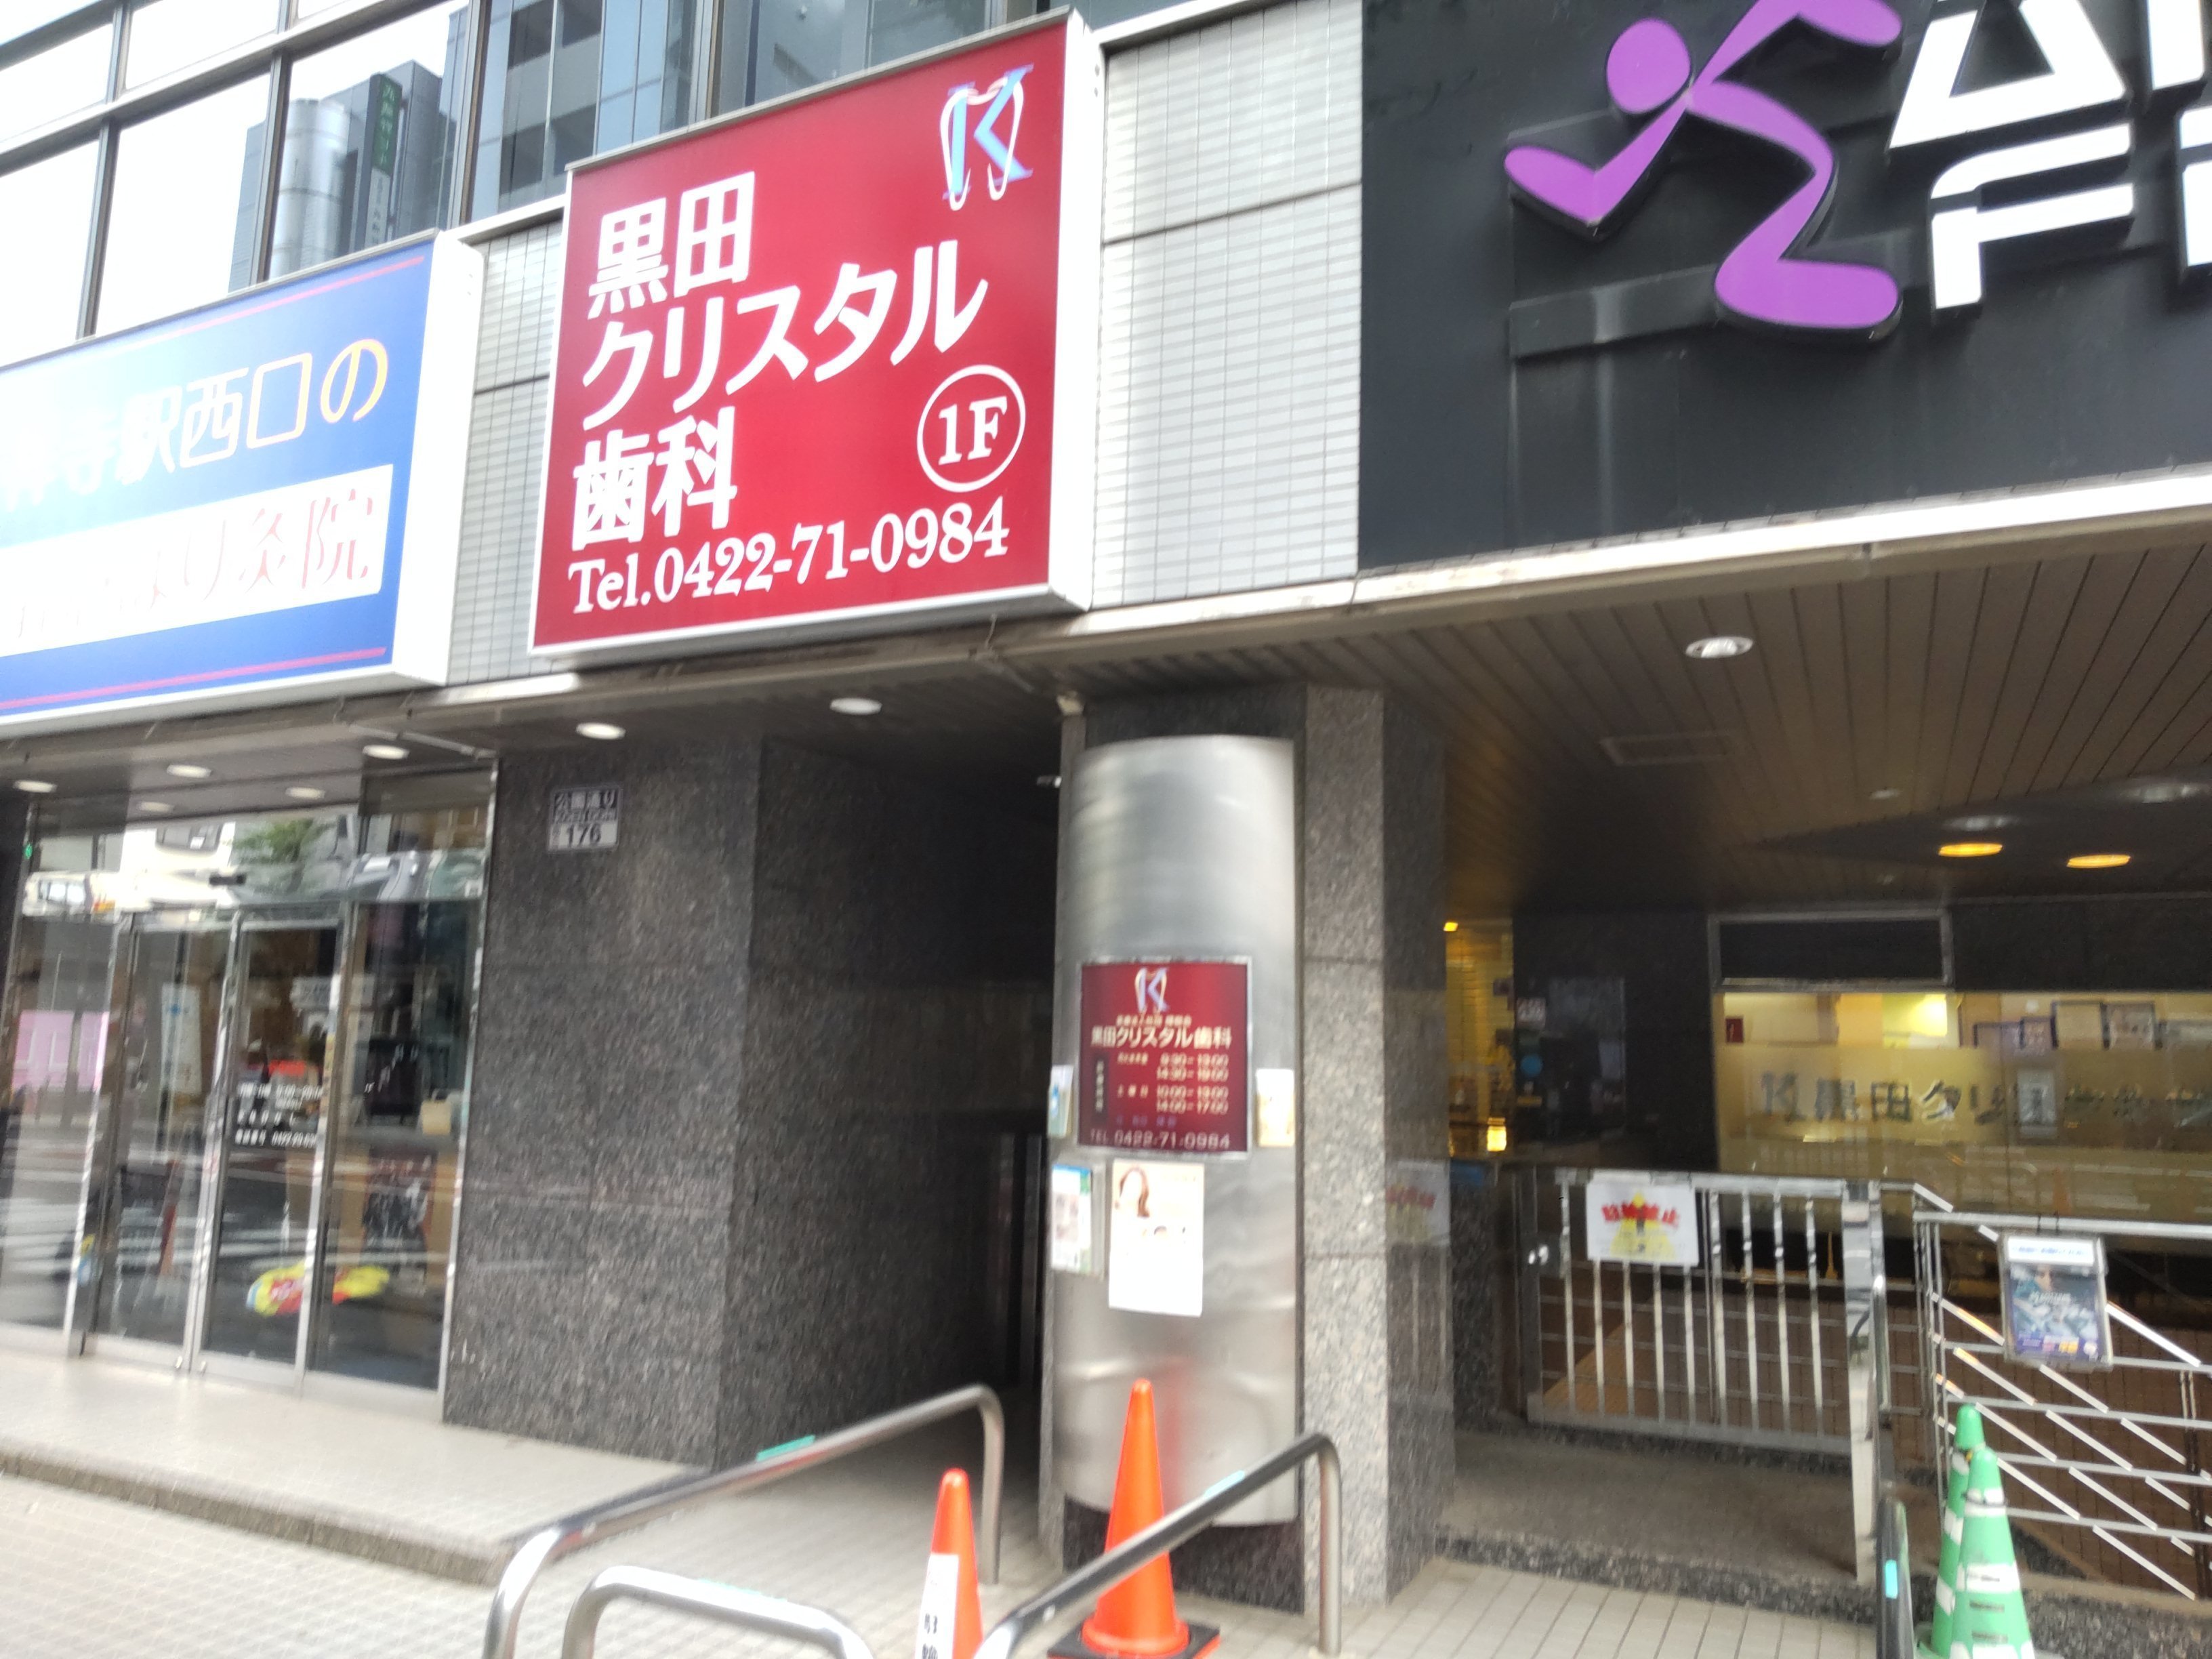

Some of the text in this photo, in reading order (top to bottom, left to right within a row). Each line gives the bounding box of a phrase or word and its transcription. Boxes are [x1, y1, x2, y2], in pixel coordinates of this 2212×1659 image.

[585, 171, 756, 320] 黒田
[582, 239, 988, 432] クリスタル
[572, 406, 737, 551] 歯科
[938, 396, 1008, 466] 1F
